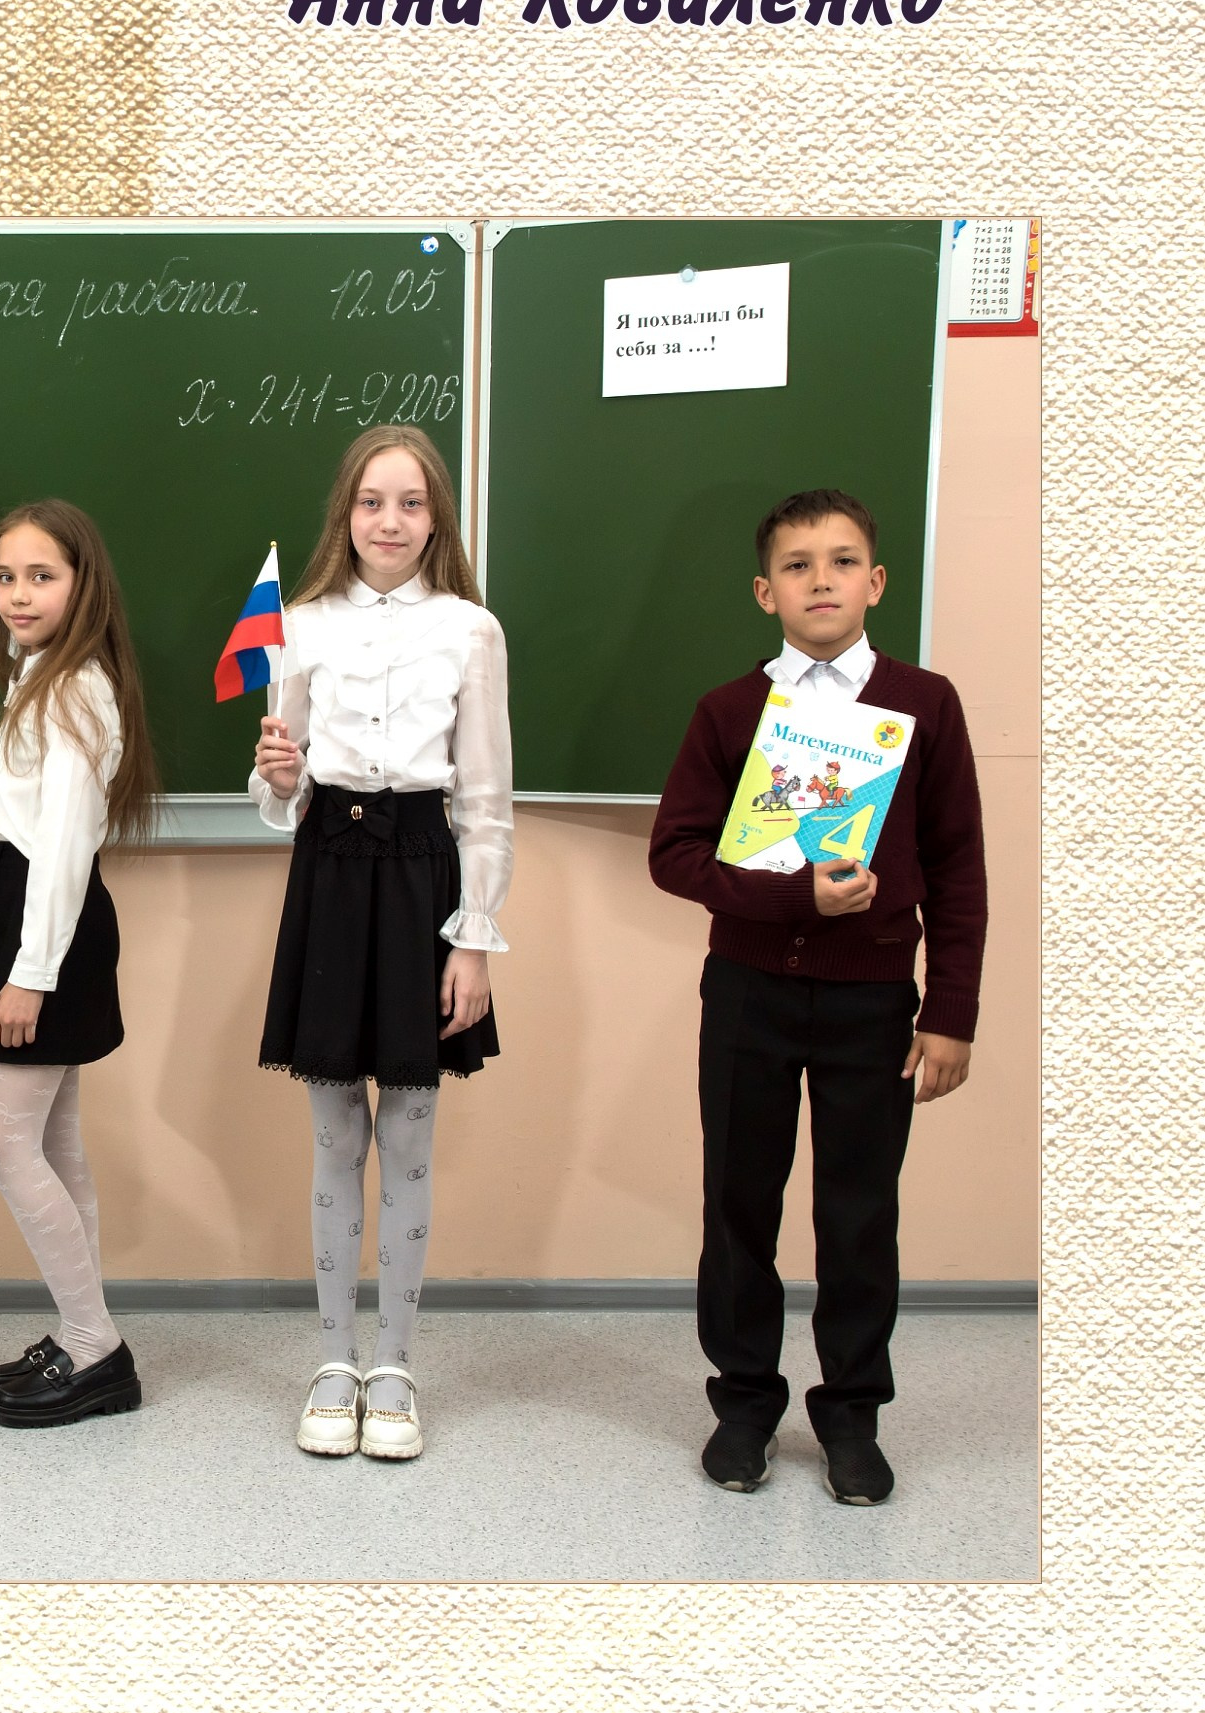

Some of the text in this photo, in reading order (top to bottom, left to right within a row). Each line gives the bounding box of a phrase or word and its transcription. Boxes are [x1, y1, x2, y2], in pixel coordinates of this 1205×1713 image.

[615, 304, 764, 330] Я похвалил бы
[615, 340, 656, 358] себя
[662, 342, 682, 355] за
[769, 722, 885, 767] Математика
[736, 829, 748, 844] 2
[818, 803, 877, 862] 4
